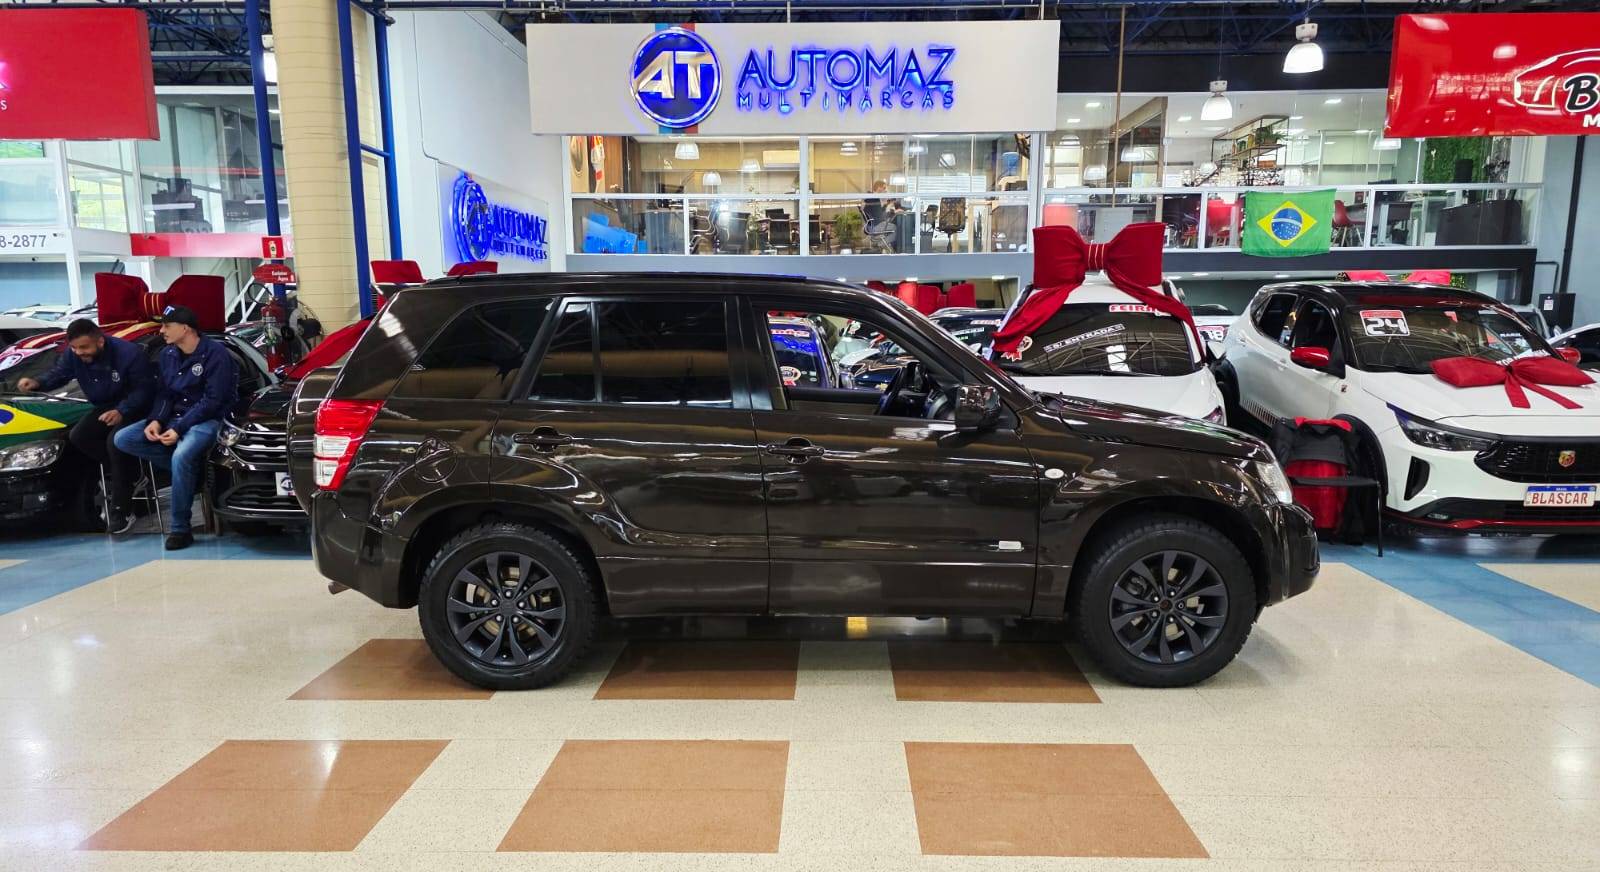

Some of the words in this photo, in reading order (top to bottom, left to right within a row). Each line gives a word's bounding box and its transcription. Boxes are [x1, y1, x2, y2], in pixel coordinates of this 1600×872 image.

[633, 50, 714, 99] AT
[738, 48, 955, 90] AUTOMAZ
[738, 90, 955, 113] MULTIMARCAS
[488, 204, 548, 244] AUTOMAZ
[1366, 318, 1407, 335] 24
[1531, 492, 1588, 504] BLASCAR
